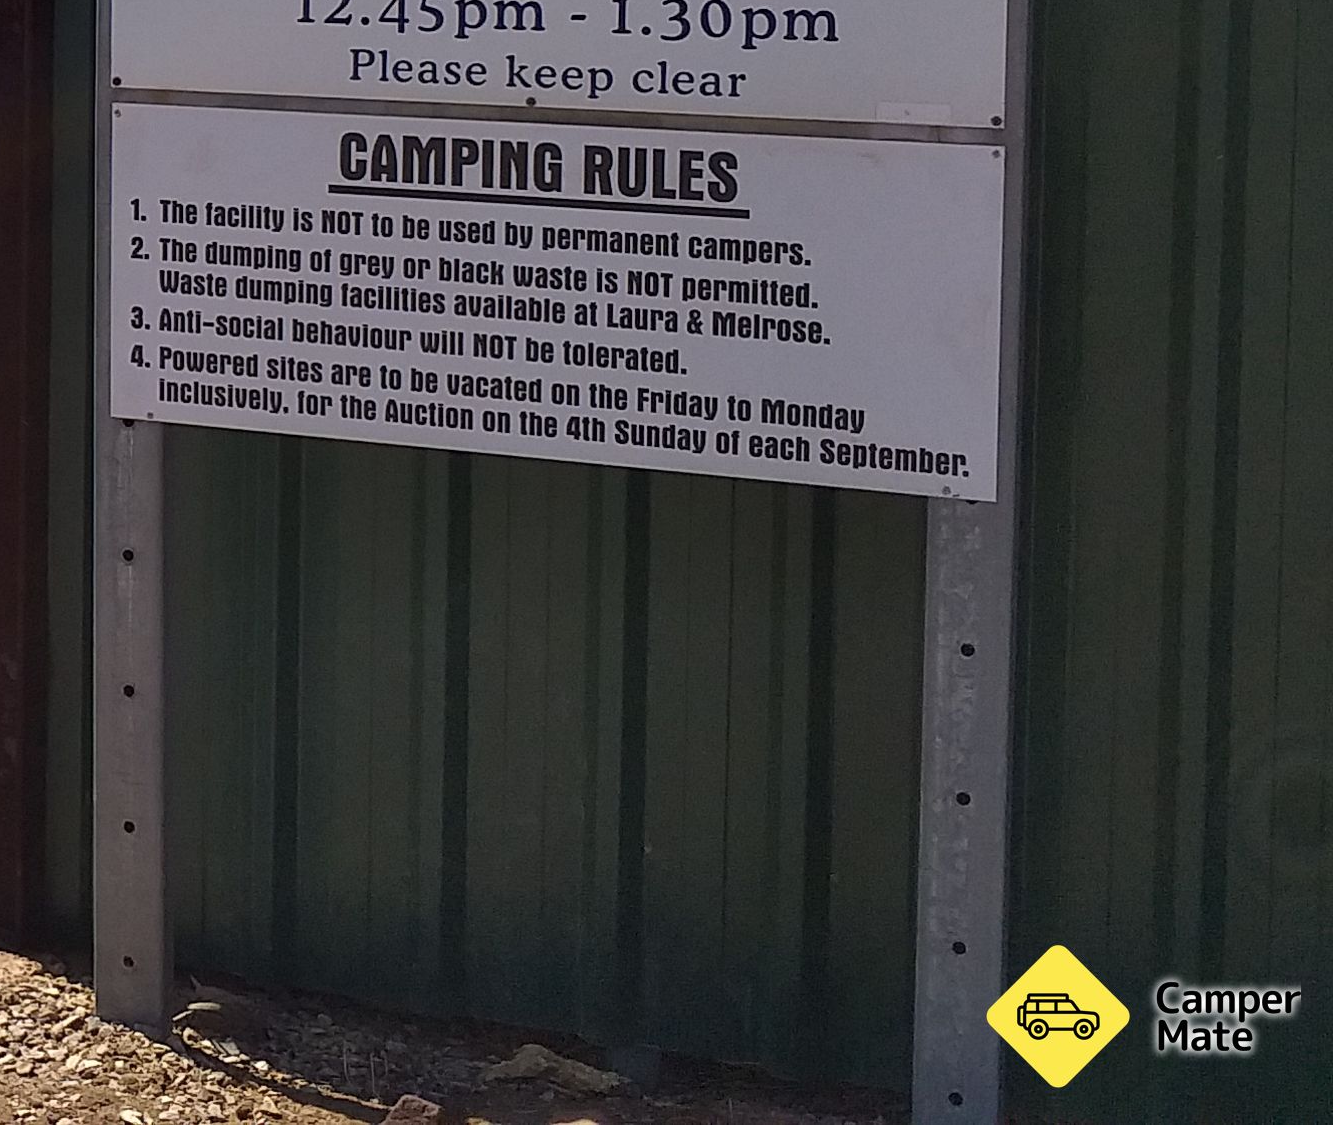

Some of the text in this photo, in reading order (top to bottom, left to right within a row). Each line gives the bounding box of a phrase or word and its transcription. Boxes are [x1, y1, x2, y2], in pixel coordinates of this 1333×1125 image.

[348, 48, 747, 100] Please keep clear
[339, 131, 739, 203] CAMPING RULES
[130, 198, 812, 266] 1. The facility is NOT to be used by permanent campers.
[130, 236, 819, 309] 2. The dumping of grey or black waste is NOT permitted.
[159, 270, 832, 345] Waste dumping facilities available at Laura & Melrose.
[130, 306, 688, 375] 3. Anti-social behaviour will NOT be tolerated.
[130, 345, 866, 434] 4. Powered sites are to be vacated on the Friday to Monday
[297, 390, 333, 418] for
[340, 393, 377, 422] the
[384, 398, 474, 432] Auction
[482, 408, 512, 435] on
[519, 408, 558, 437] the
[565, 416, 606, 444] 4th
[614, 420, 707, 454] Sunday
[715, 430, 742, 456] of
[748, 433, 810, 462] each
[819, 437, 970, 478] September.
